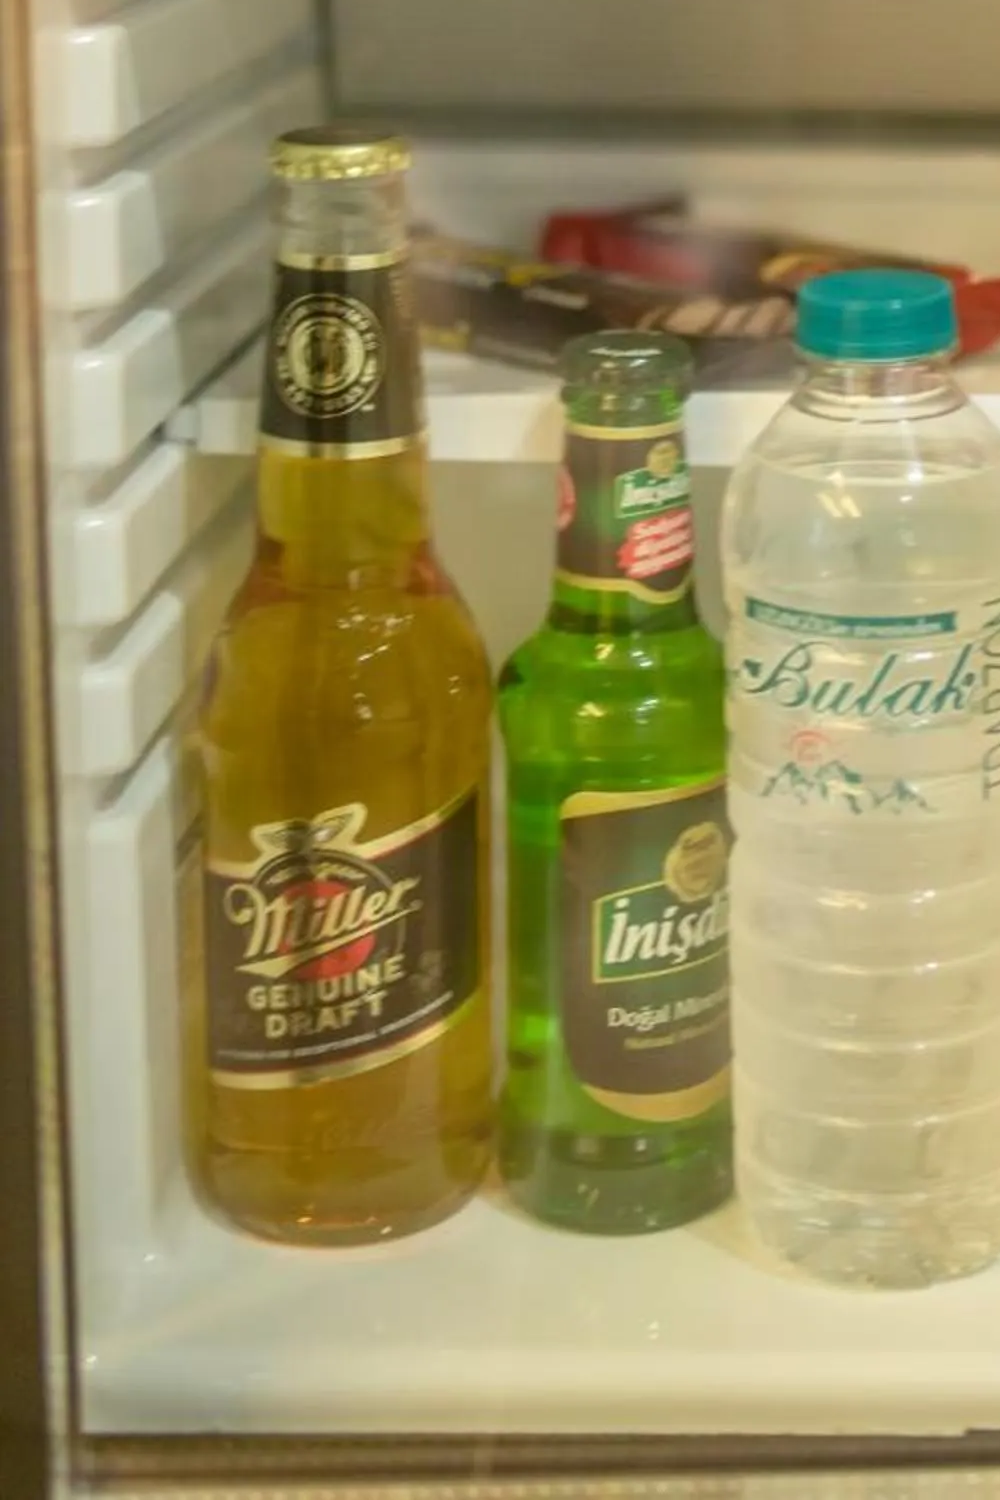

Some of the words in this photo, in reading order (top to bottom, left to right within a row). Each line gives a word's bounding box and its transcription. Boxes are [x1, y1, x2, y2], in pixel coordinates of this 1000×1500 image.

[744, 640, 976, 717] Bulak
[224, 875, 421, 960] Miller
[246, 953, 406, 1012] GENUINE
[264, 990, 389, 1039] DRAFT
[606, 1003, 671, 1033] Doğal
